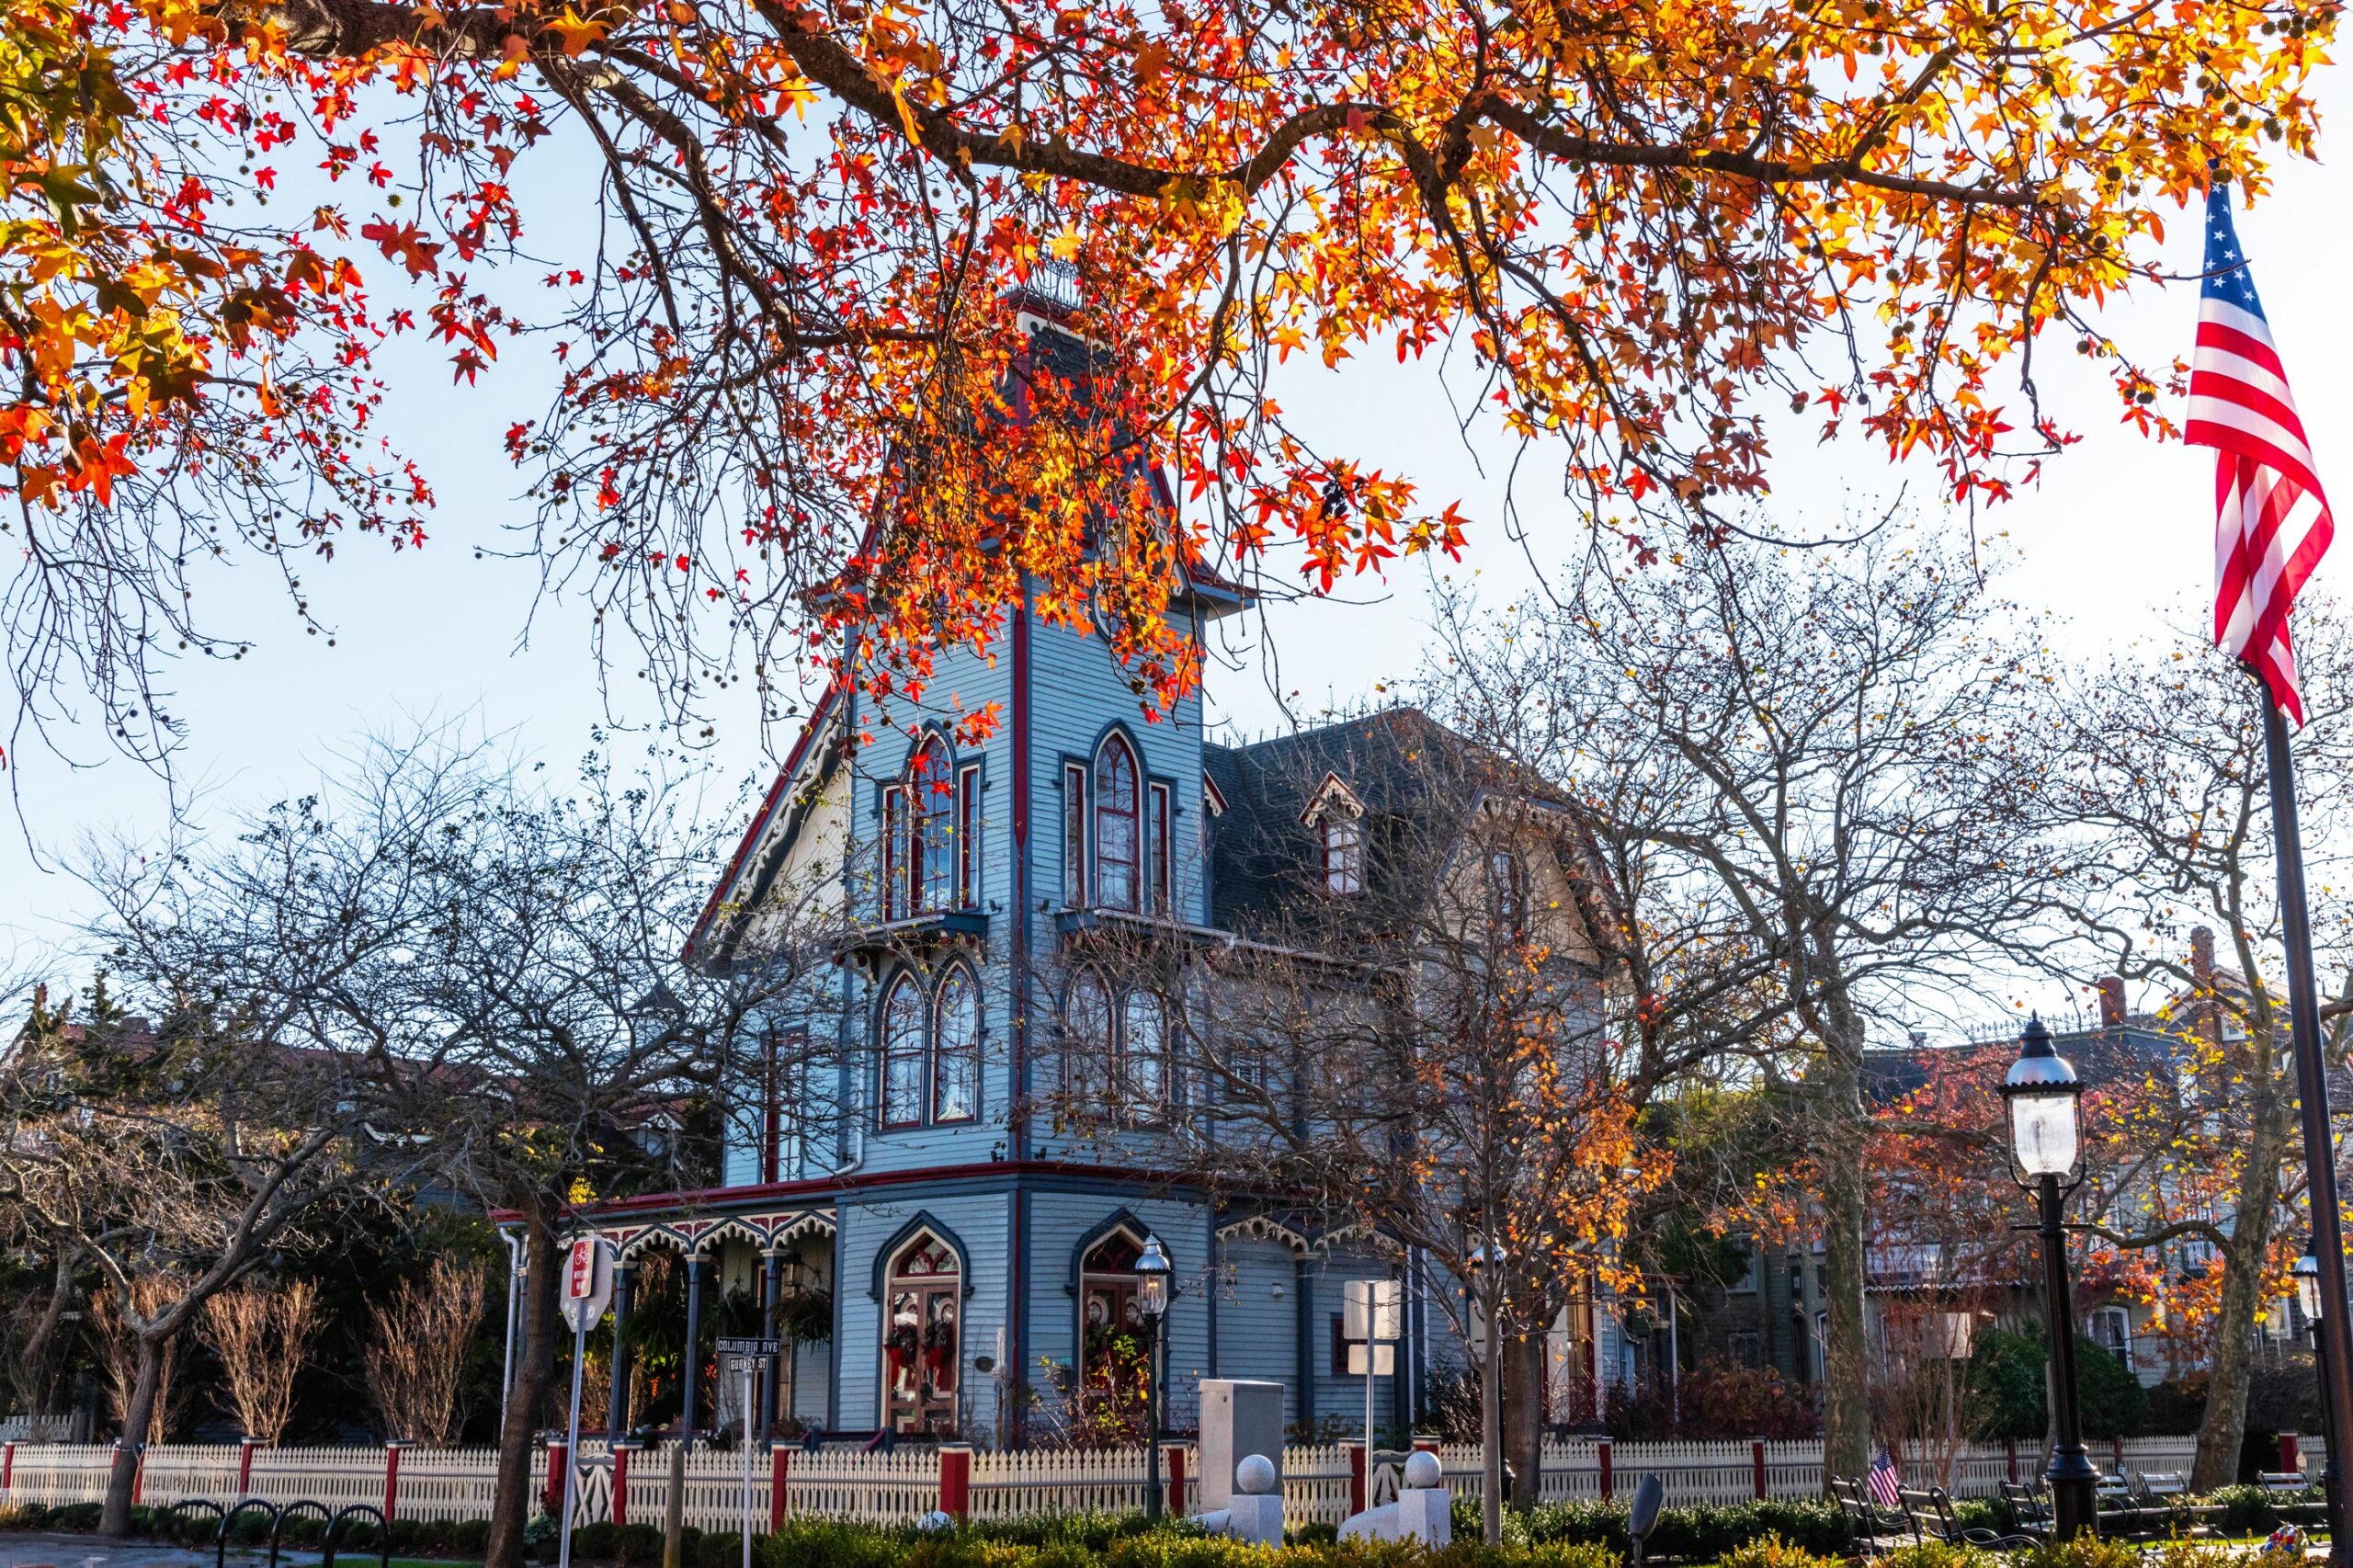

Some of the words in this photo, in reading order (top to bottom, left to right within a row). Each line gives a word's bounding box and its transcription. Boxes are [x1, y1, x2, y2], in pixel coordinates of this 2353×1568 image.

[718, 1340, 758, 1352] COLUMBIA
[763, 1341, 779, 1353] AVE
[731, 1358, 756, 1370] GURNEY
[758, 1358, 767, 1369] ST
